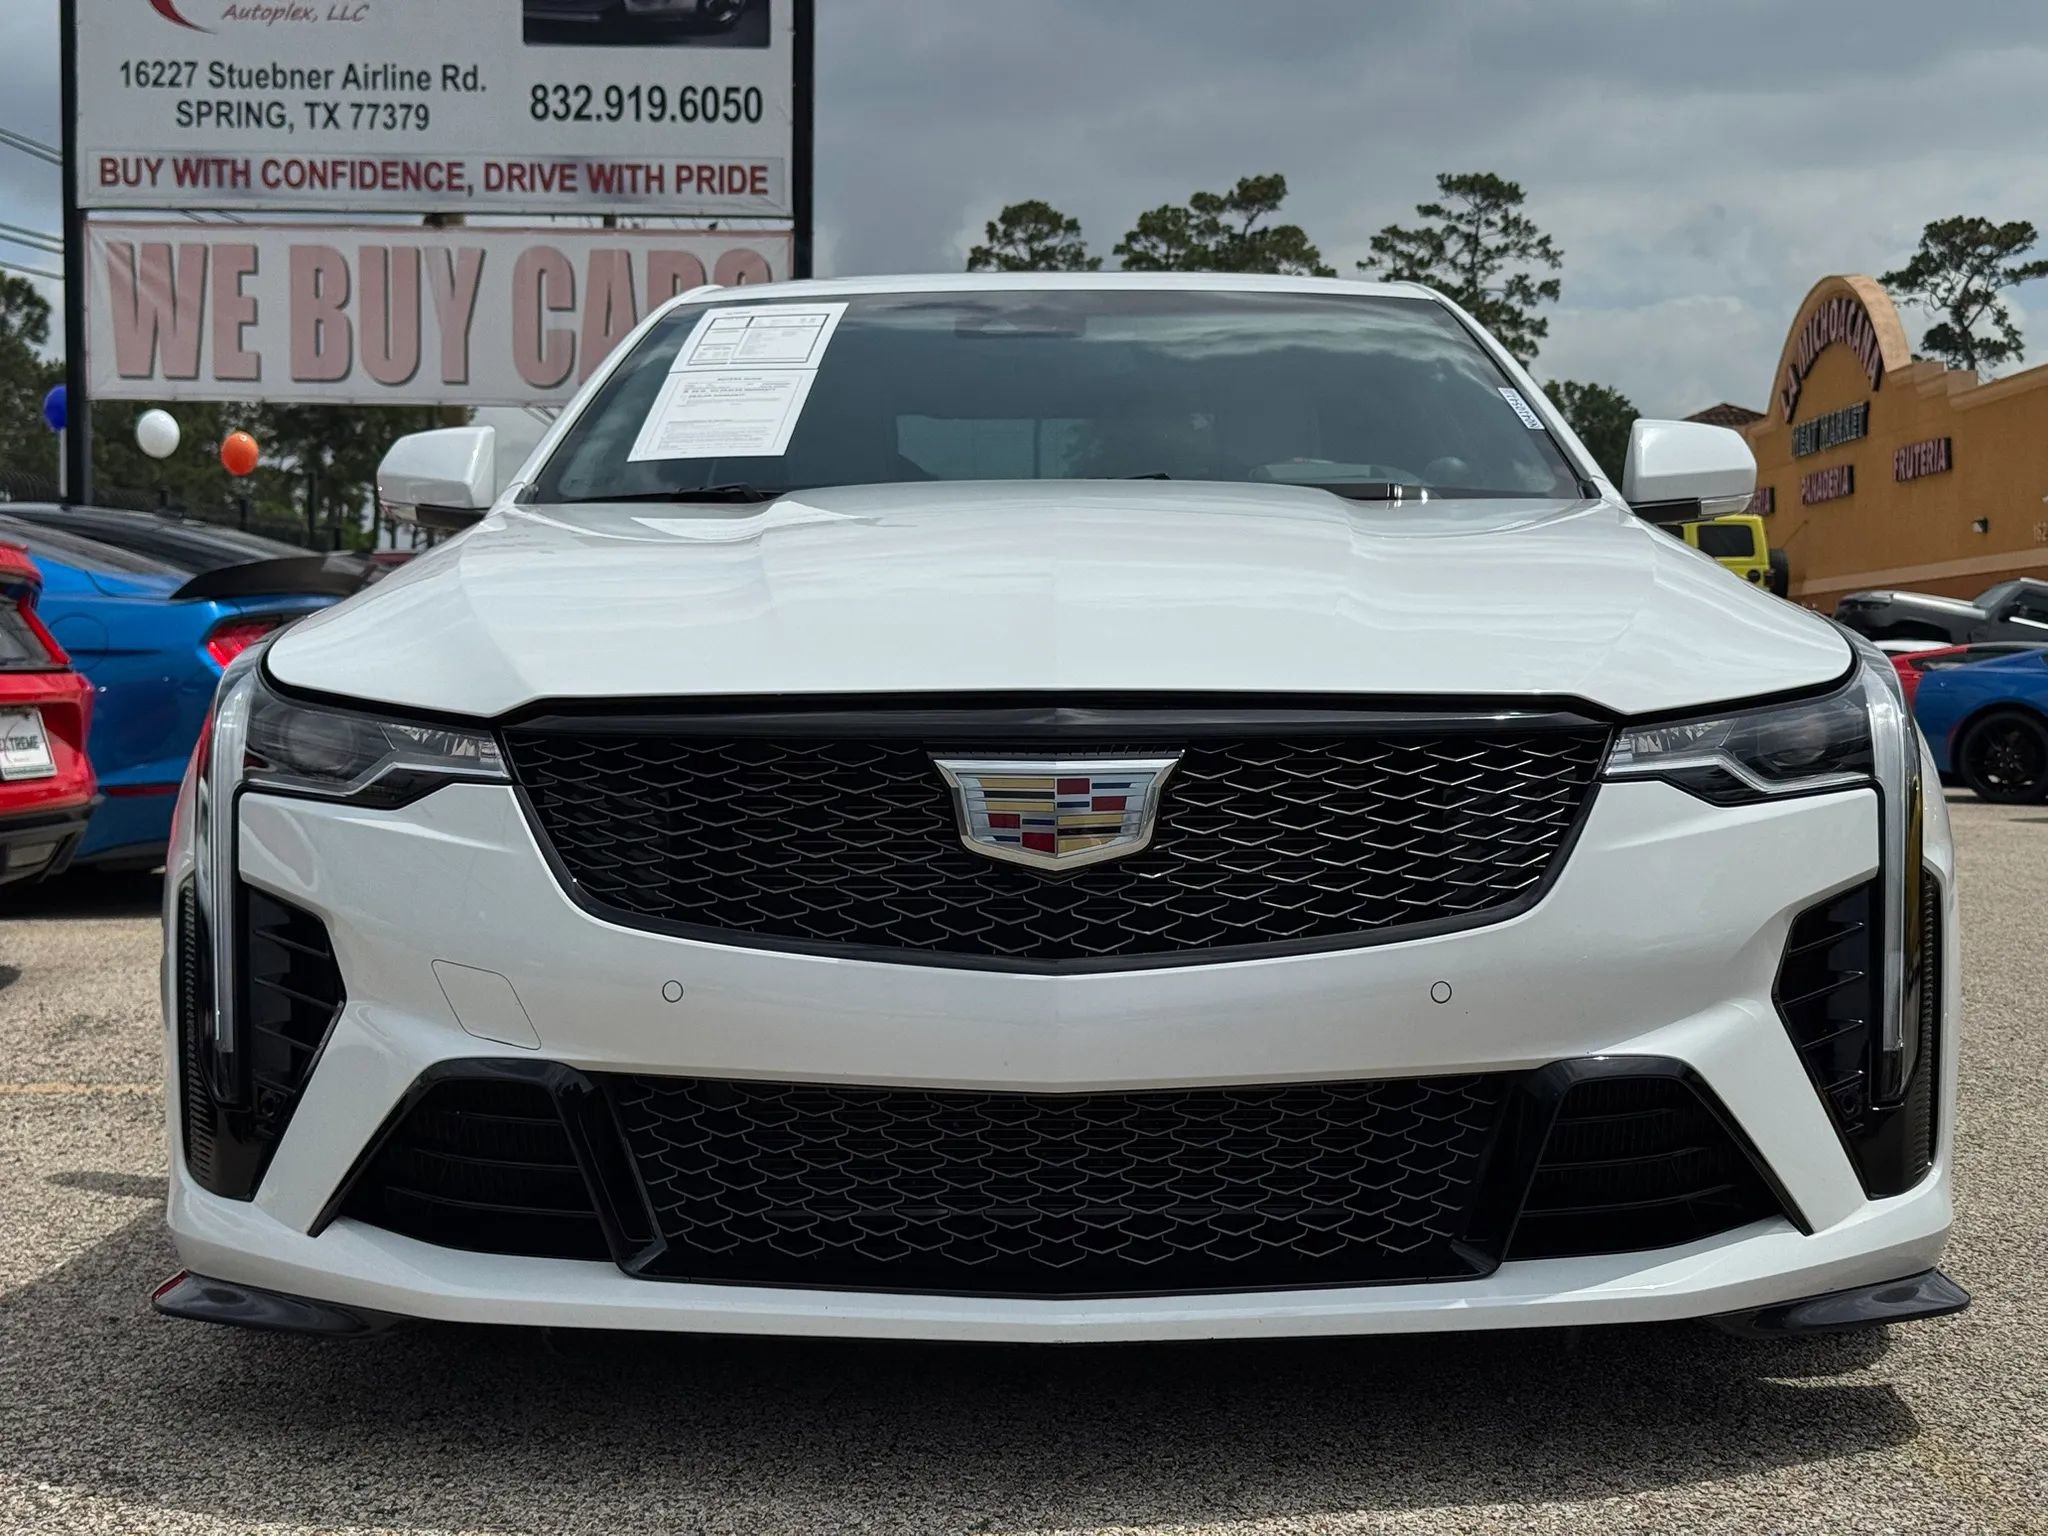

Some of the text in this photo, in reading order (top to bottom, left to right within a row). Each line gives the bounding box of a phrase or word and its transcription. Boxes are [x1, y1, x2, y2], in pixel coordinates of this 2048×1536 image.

[221, 4, 370, 26] Autoplex, LLC
[120, 60, 487, 92] 16227 Stuebner Airline Rd.
[175, 100, 430, 133] SPRING, TX 77379
[530, 84, 763, 124] 832.919.6050
[100, 157, 769, 197] BUY WITH CONFIDENCE, DRIVE WITH PRIDE
[105, 241, 261, 381] WE
[289, 244, 486, 386] BUY
[1781, 297, 1882, 424] LA MICHOACANA
[1819, 401, 1869, 451] MARKET
[1893, 437, 1952, 482] FRUTERIA
[1801, 464, 1854, 505] PANADERIA
